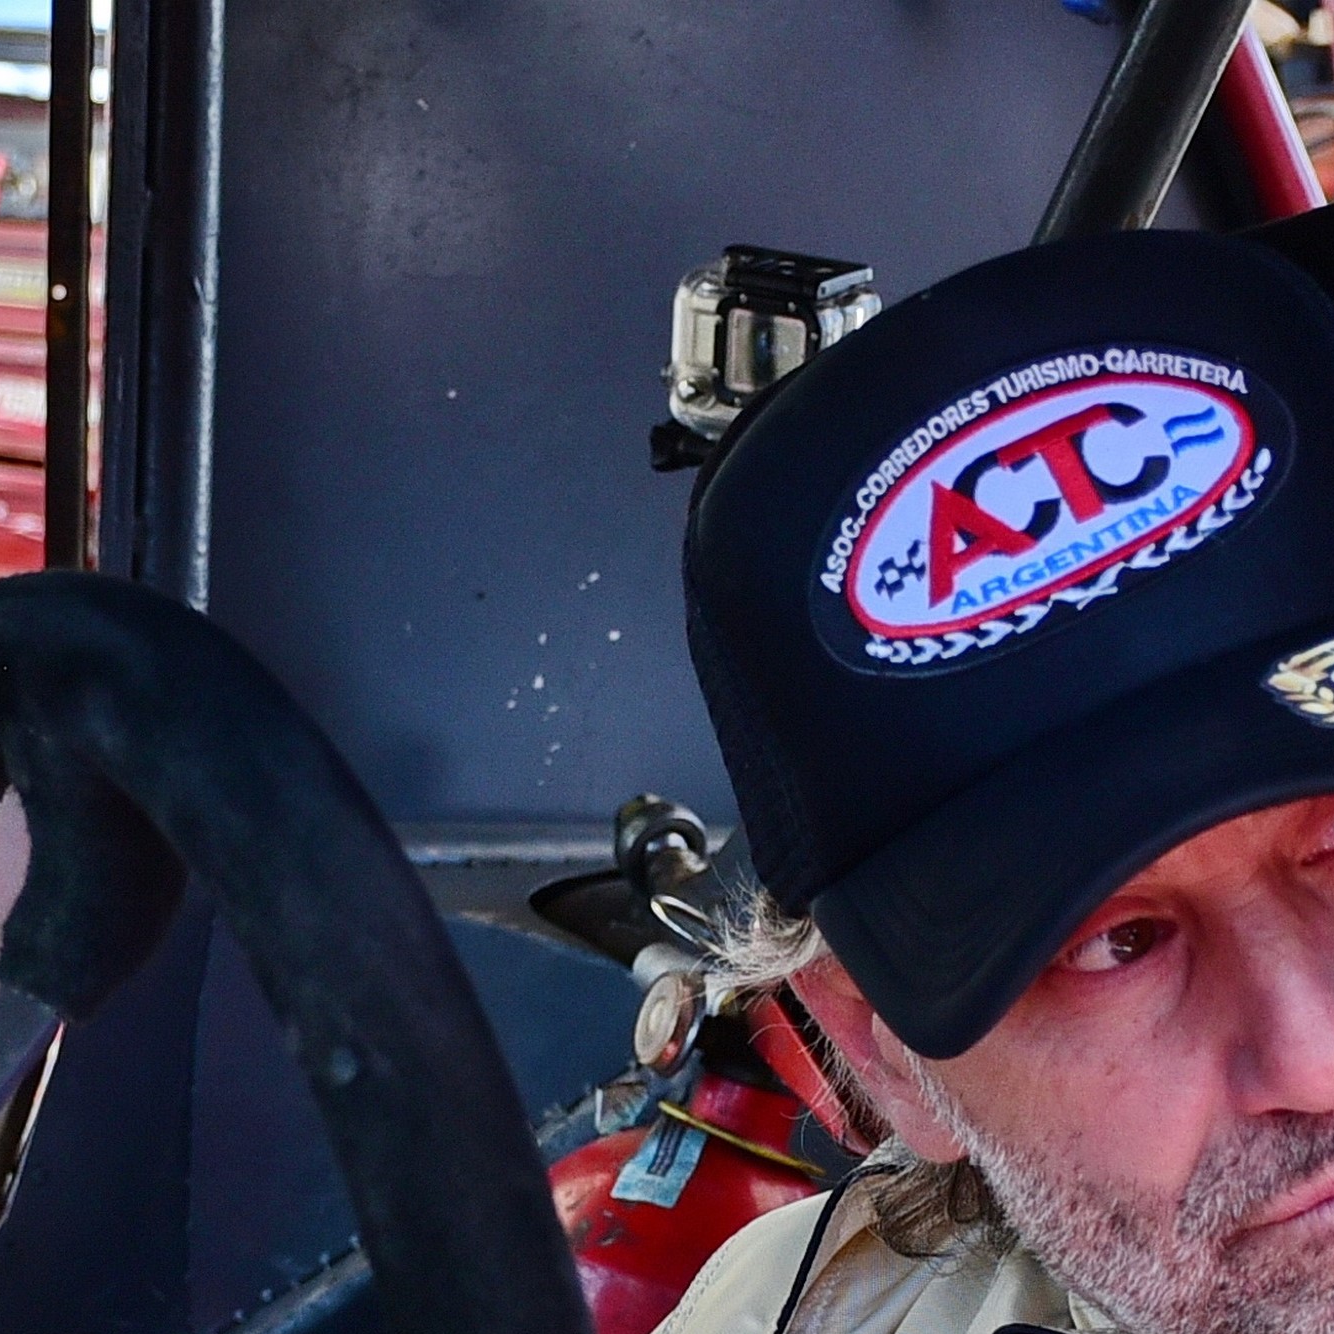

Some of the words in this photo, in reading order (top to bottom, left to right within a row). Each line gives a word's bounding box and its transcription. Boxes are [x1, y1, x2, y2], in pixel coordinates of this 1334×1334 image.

[856, 389, 990, 511] CORREDORES
[928, 402, 1172, 609] ACTC
[950, 482, 1201, 616] ARGENTINA
